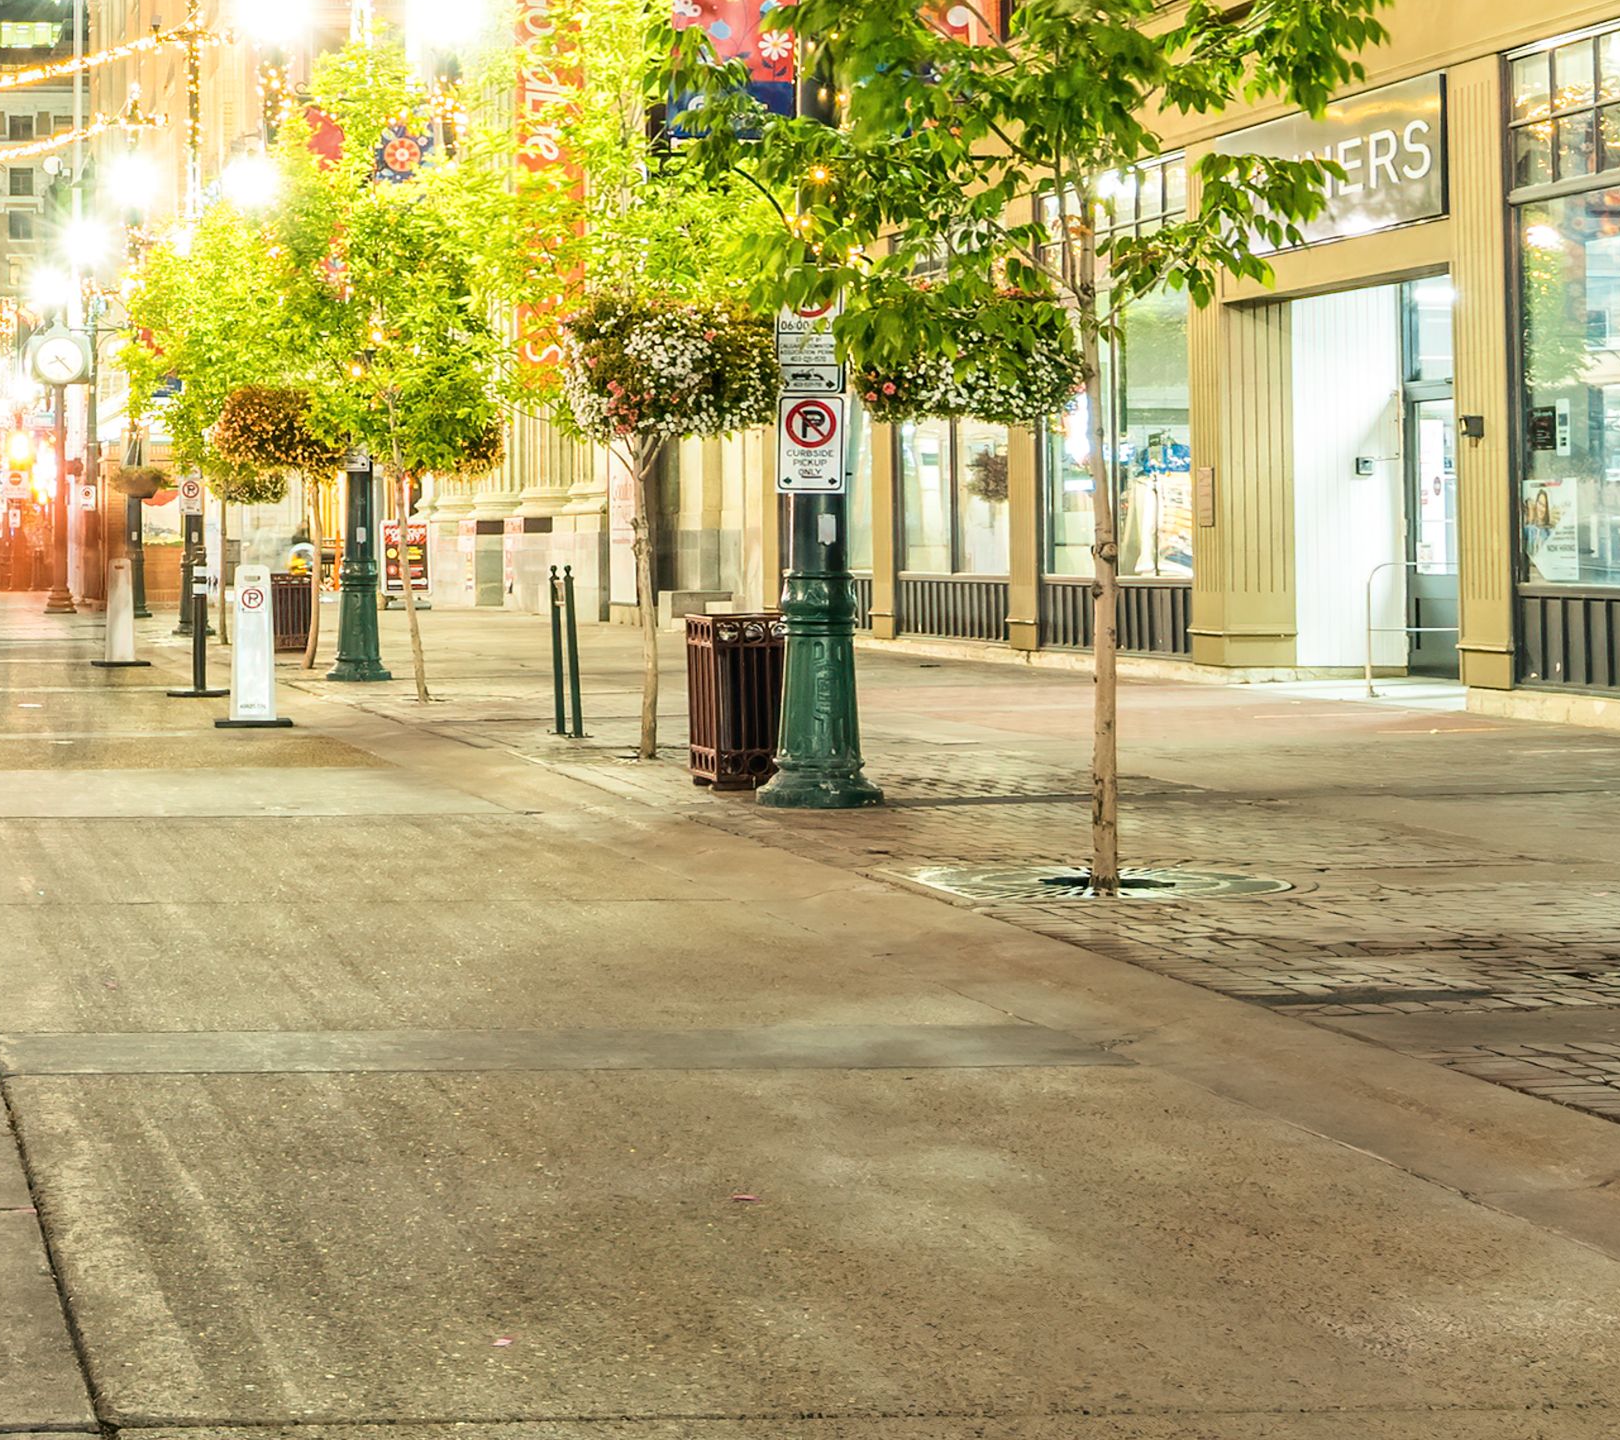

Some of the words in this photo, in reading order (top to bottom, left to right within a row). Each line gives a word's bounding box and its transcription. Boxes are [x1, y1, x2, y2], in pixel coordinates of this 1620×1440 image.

[1305, 119, 1433, 201] NERS
[786, 449, 835, 458] CURBSIDE
[793, 458, 827, 466] PICKUP
[798, 468, 822, 476] ONLY
